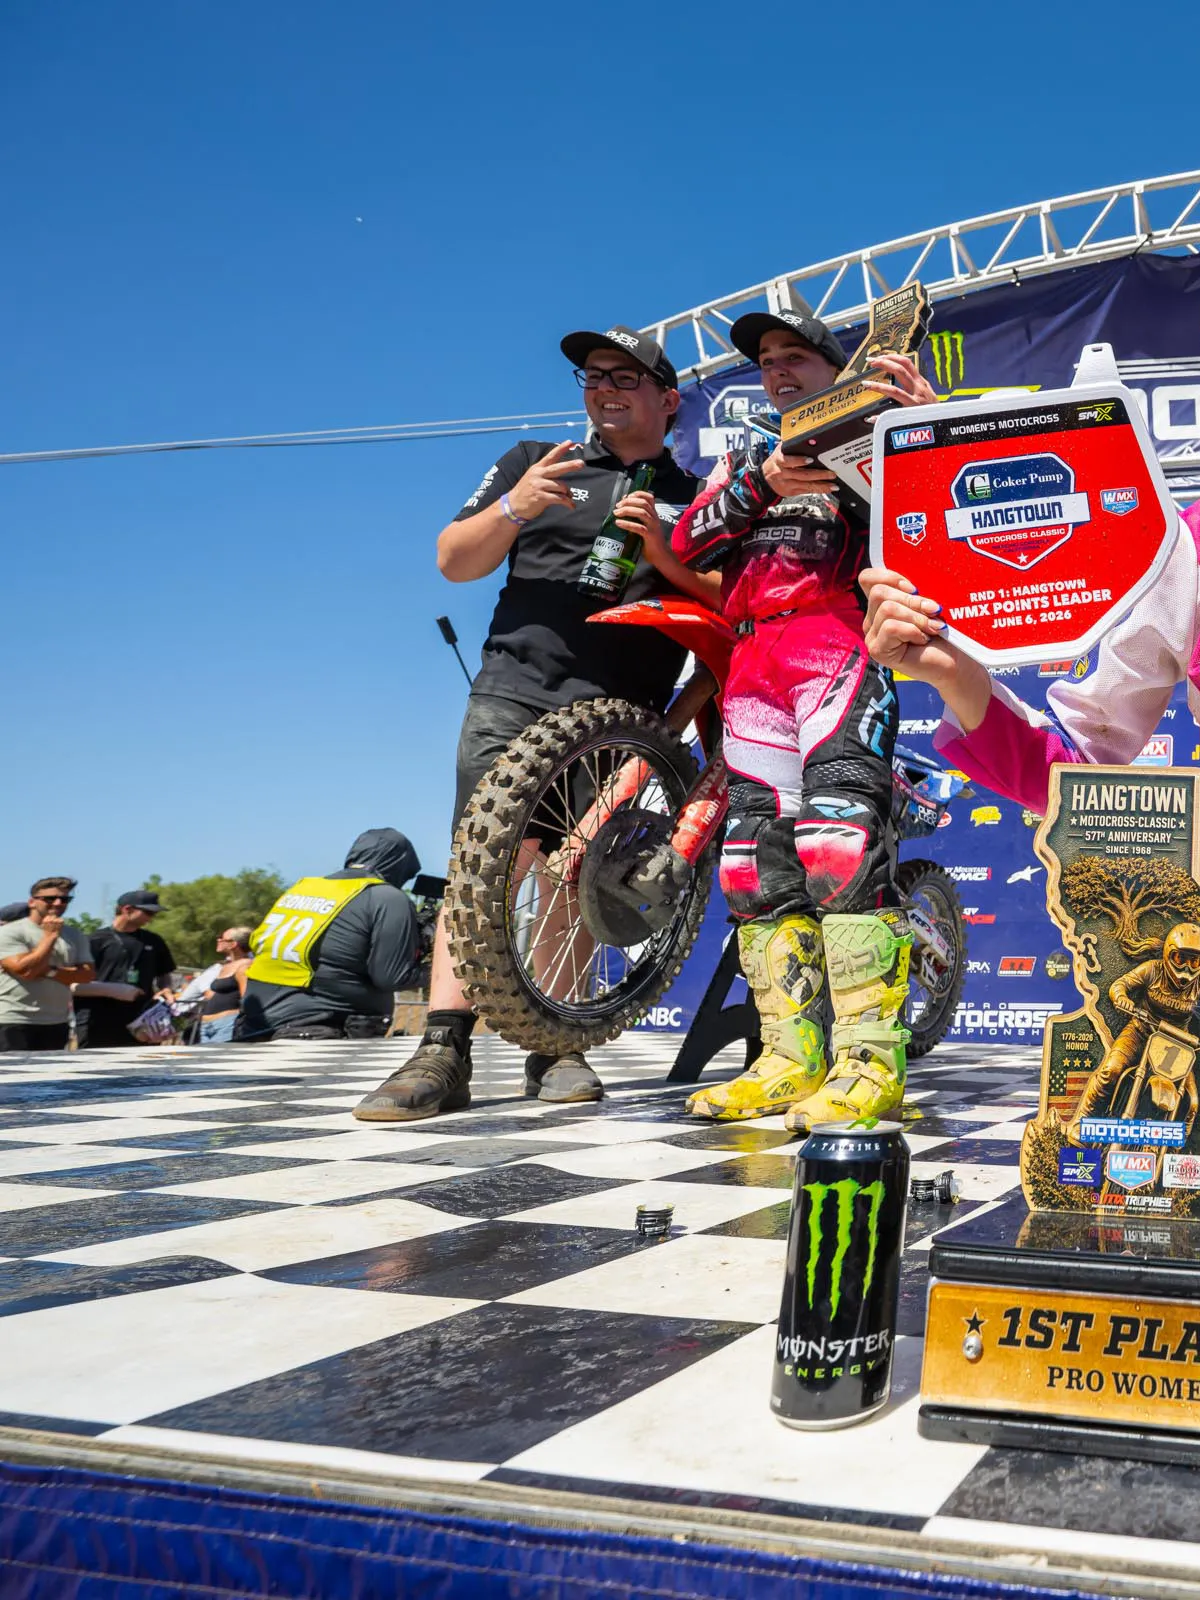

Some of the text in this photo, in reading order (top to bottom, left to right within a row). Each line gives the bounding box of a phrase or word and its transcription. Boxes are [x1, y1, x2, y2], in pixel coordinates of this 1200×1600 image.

[875, 288, 914, 314] HANGTOWN
[751, 402, 779, 414] Cok
[798, 380, 870, 420] 2ND PLAC
[812, 398, 857, 423] PRO WOMEN
[894, 406, 1113, 447] WMX WOMEN'S MOTOCROSS SMX
[993, 475, 1028, 489] Coker
[1029, 471, 1064, 487] Pump
[1104, 491, 1133, 503] WMX
[971, 501, 1064, 530] HANGTOWN
[976, 528, 1065, 545] MOTOCROSS CLASSIC
[970, 579, 1087, 602] RND 1: HANGTOWN
[950, 589, 1112, 621] WMX POINTS LEADER
[991, 610, 1072, 629] JUNE 6, 2026
[1141, 740, 1167, 756] MX
[685, 759, 724, 818] DUNLO
[1071, 784, 1187, 814] HANGTOWN
[1080, 815, 1177, 829] MOTOCROSS-CLASSIC
[1085, 830, 1171, 844] 57TH ANNIVERSARY
[1105, 845, 1151, 855] SINCE 1968
[1150, 990, 1193, 1012] HANGTOWN
[641, 1007, 682, 1027] NBC
[952, 1010, 1063, 1029] TOCROS
[951, 1027, 1041, 1036] MPIONSH
[1062, 1033, 1094, 1042] 1776-2026
[1065, 1042, 1089, 1051] HONOR
[1081, 1124, 1184, 1140] MOTOCROSS
[1081, 1135, 1184, 1146] CHAMPIONSHIP
[1111, 1155, 1151, 1170] WMX
[1063, 1166, 1094, 1179] SMX
[998, 1306, 1094, 1354] 1ST
[777, 1328, 890, 1363] MONSTER
[784, 1359, 875, 1379] ENERGY
[1046, 1365, 1105, 1393] PRO
